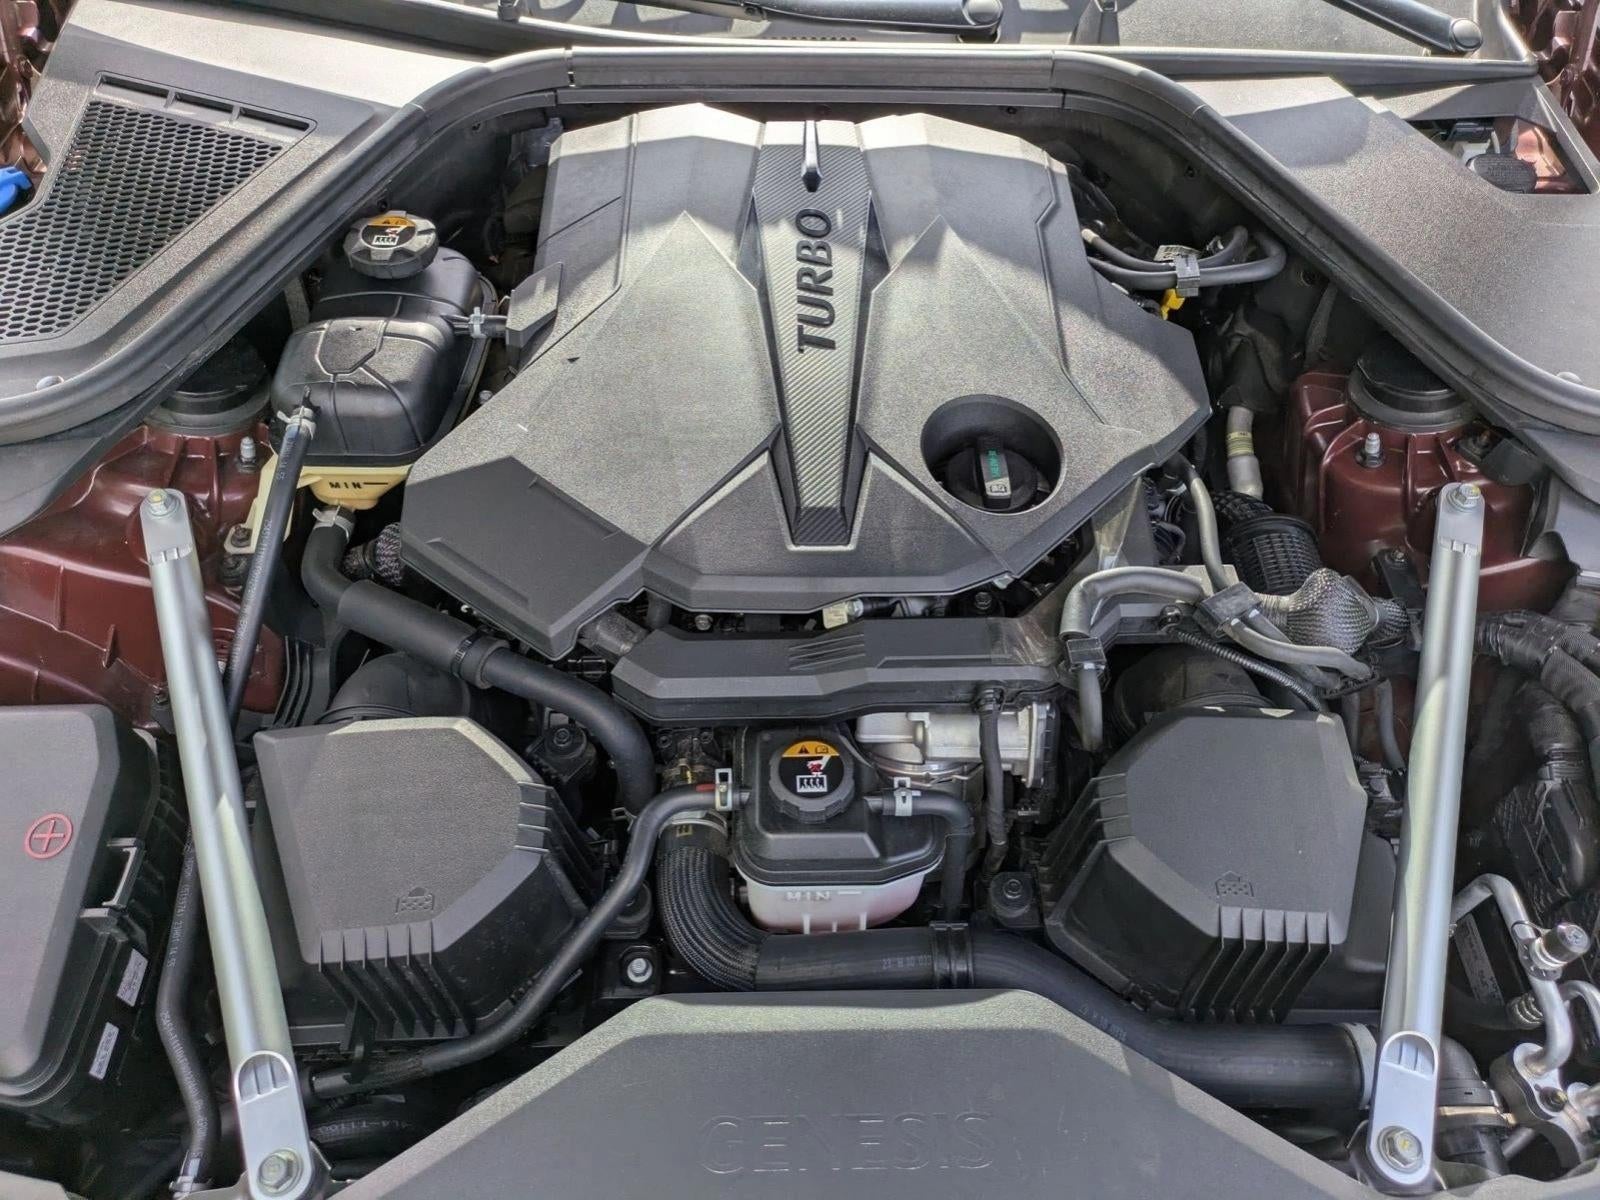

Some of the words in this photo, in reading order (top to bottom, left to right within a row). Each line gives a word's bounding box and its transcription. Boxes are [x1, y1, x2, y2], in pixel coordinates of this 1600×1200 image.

[795, 208, 837, 353] TURBO
[329, 481, 363, 490] MIN
[786, 890, 833, 902] MIN
[698, 1112, 994, 1174] GENESIS
